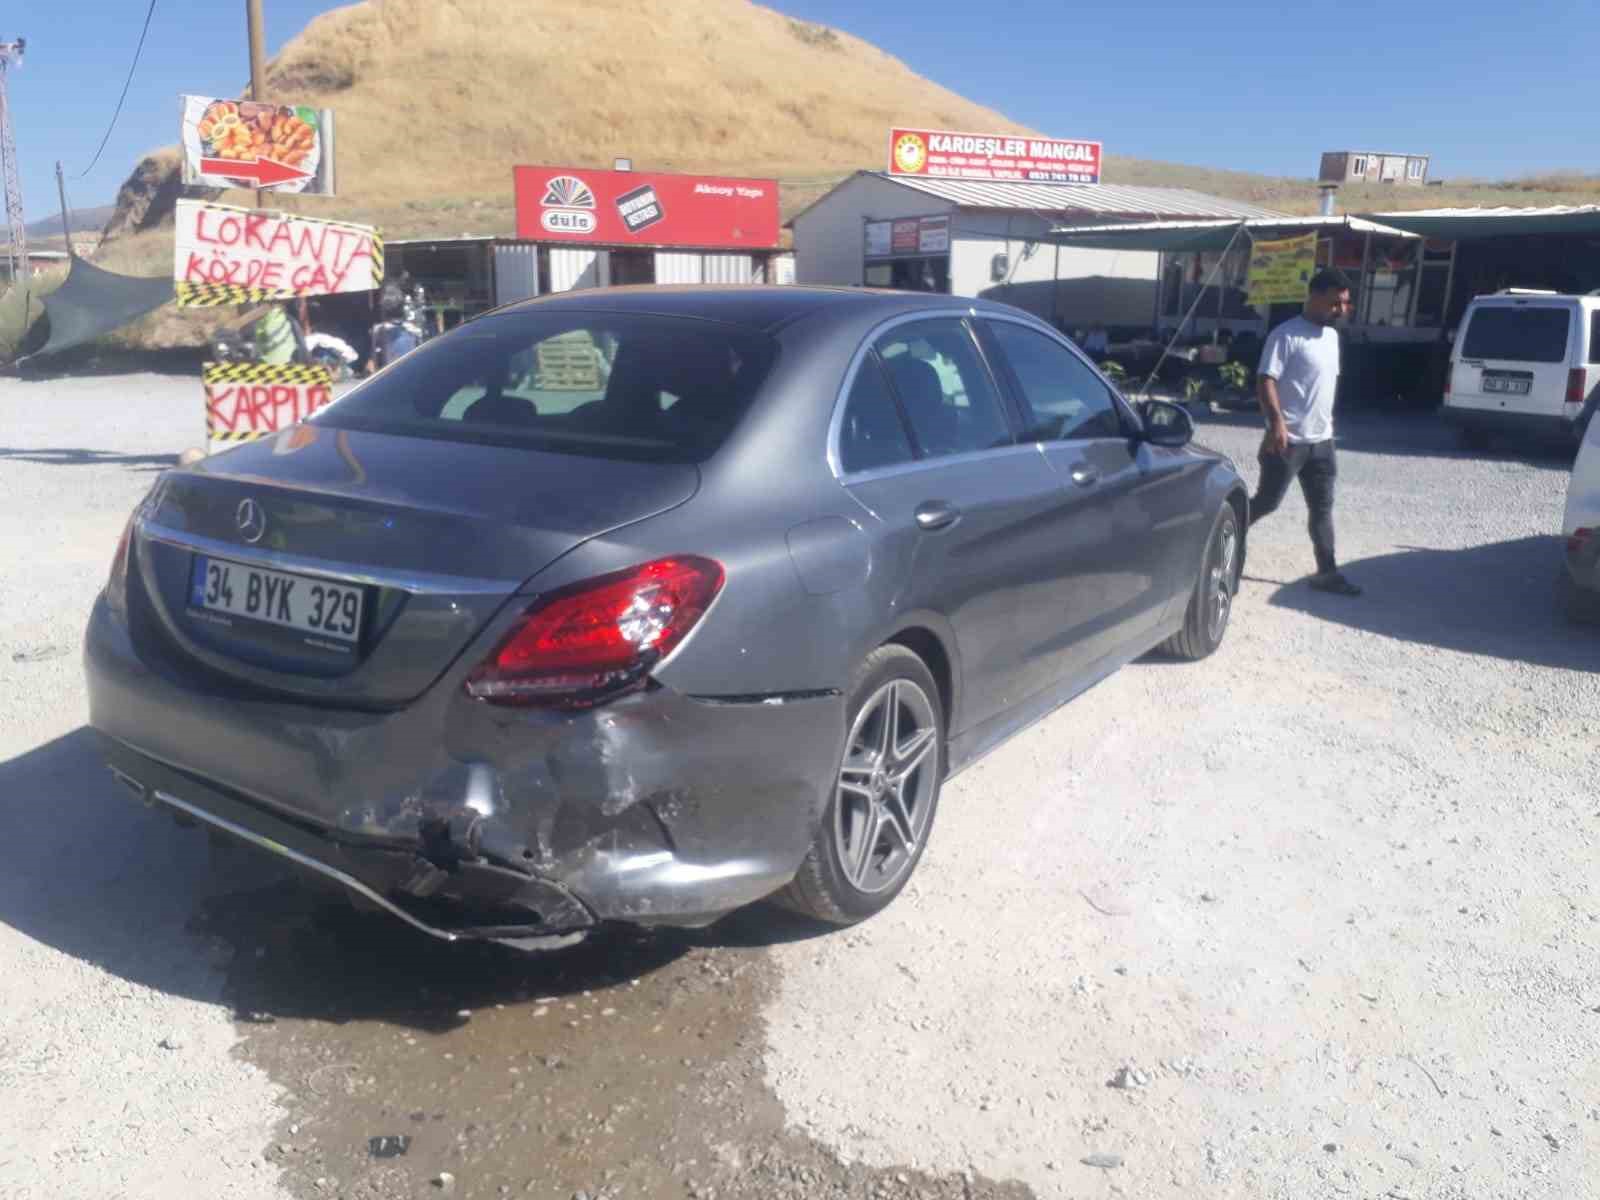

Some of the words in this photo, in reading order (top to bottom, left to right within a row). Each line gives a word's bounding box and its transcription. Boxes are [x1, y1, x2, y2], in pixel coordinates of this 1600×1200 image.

[928, 135, 1026, 159] KARDEŞLER
[1030, 142, 1094, 161] MANGAL
[185, 249, 284, 289] KÖZDE
[207, 564, 233, 607] 34
[245, 572, 296, 622] BYK
[307, 585, 358, 635] 329
